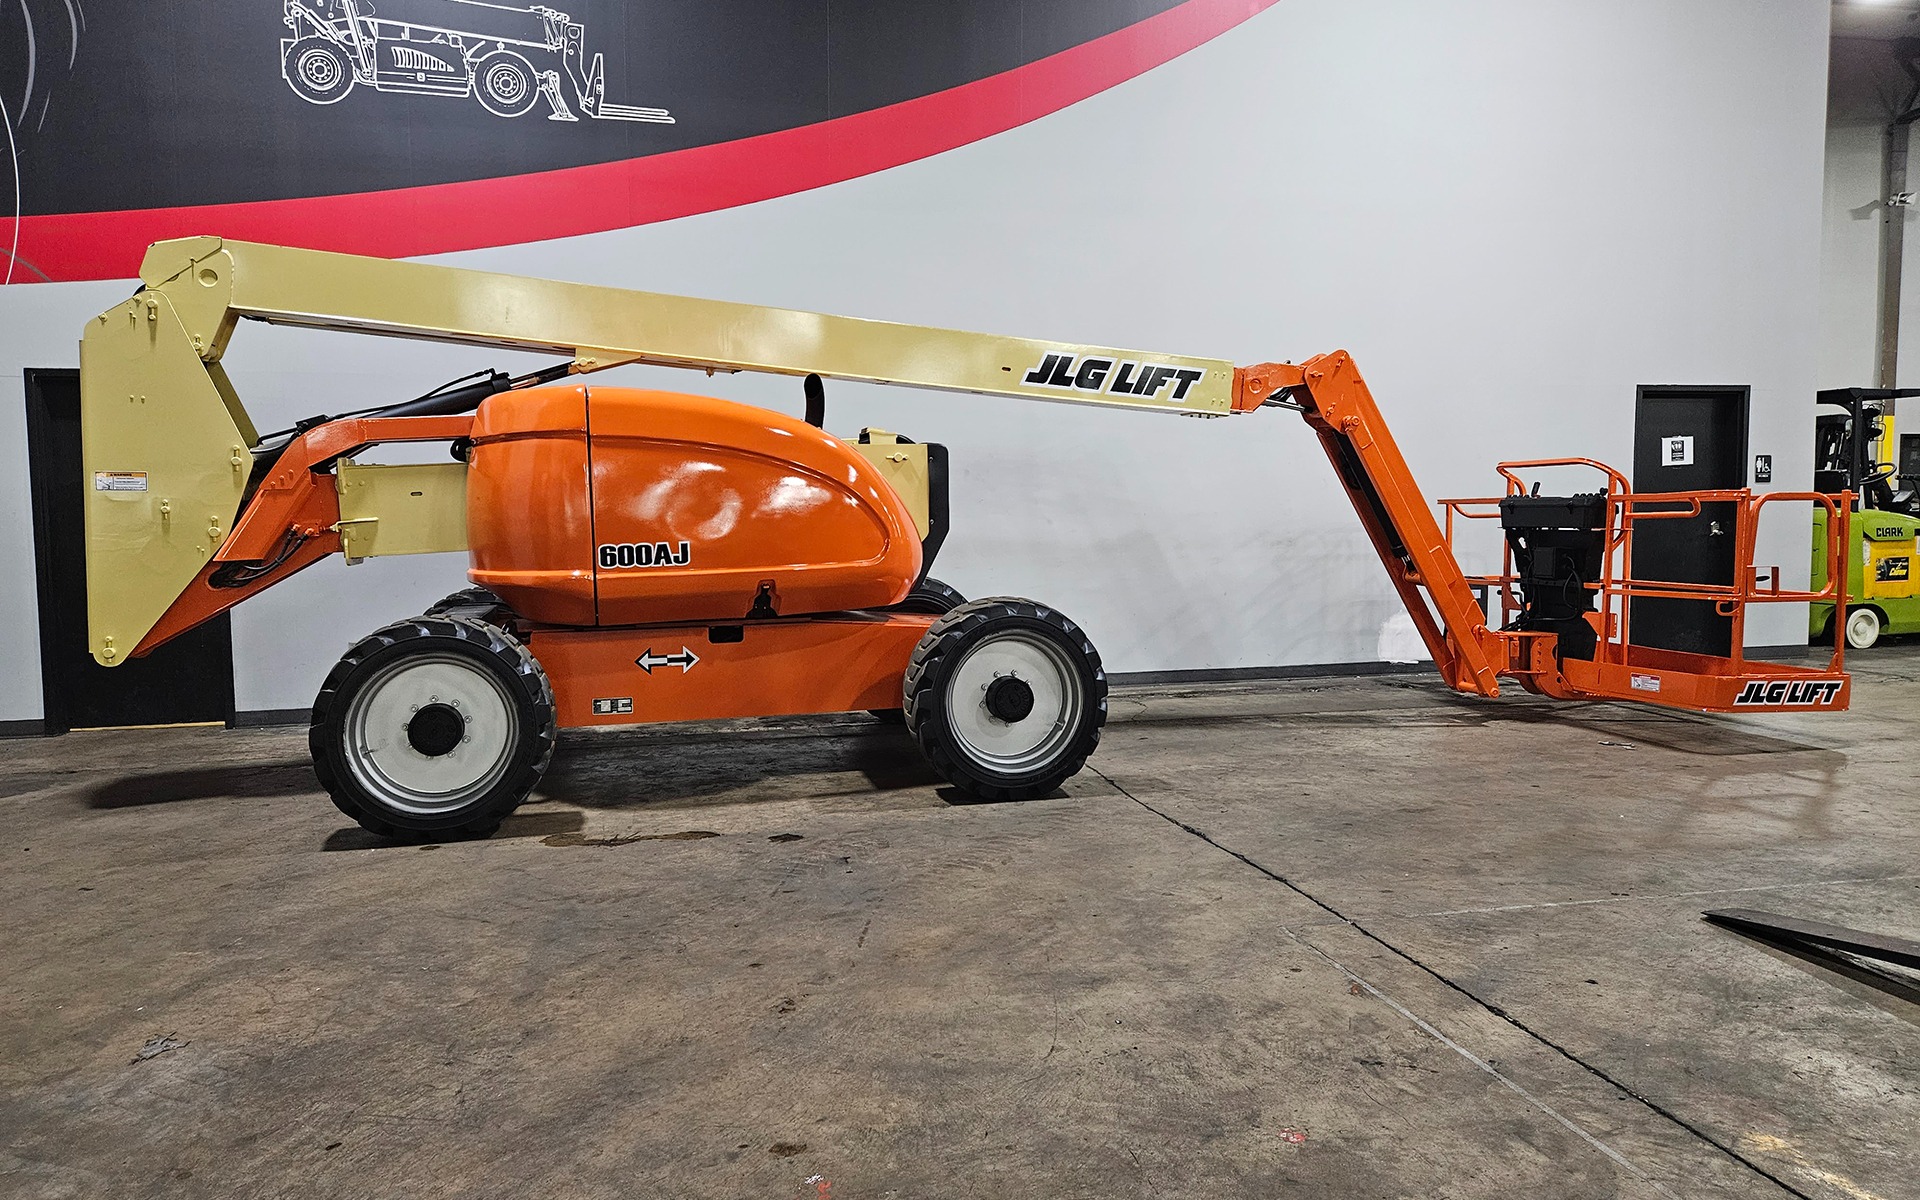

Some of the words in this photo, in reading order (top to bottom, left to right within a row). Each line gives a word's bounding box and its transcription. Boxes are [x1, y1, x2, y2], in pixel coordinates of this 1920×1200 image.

[1022, 352, 1116, 392] JLG
[1107, 361, 1205, 401] LIFT
[1876, 527, 1904, 537] CLARK
[599, 541, 690, 568] 600AJ
[1734, 681, 1789, 704] JLG
[1784, 681, 1843, 704] LIFT
